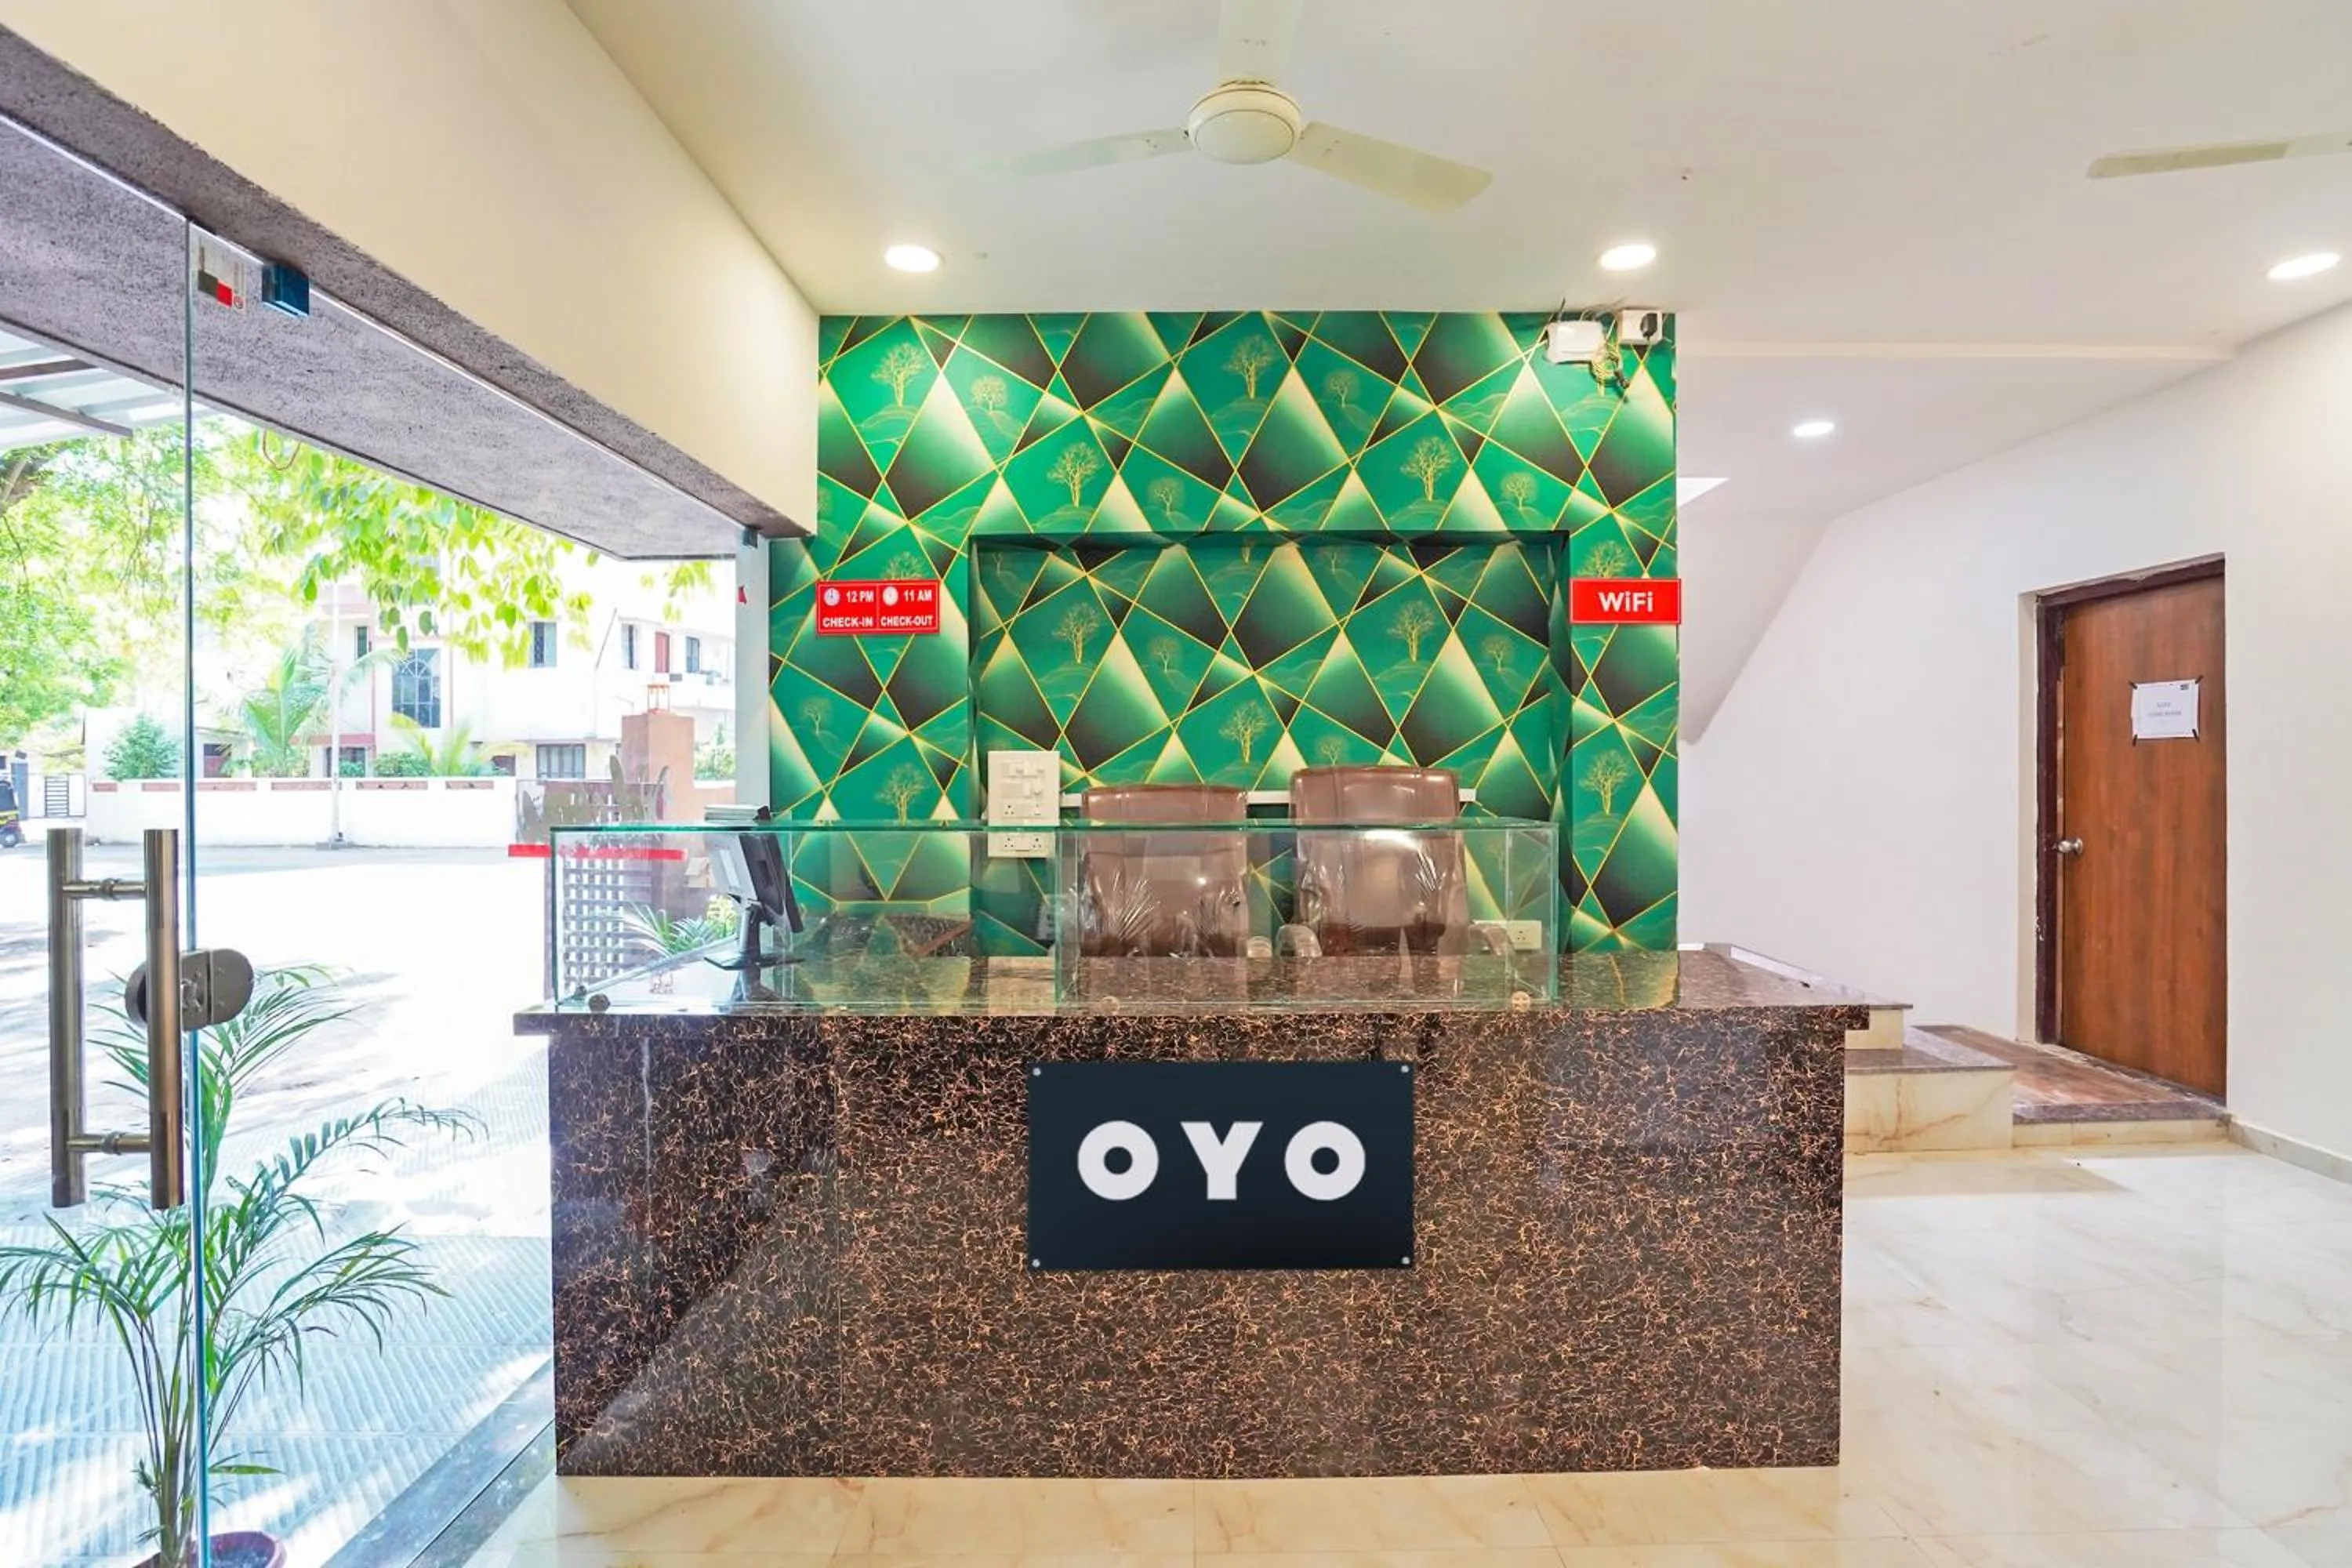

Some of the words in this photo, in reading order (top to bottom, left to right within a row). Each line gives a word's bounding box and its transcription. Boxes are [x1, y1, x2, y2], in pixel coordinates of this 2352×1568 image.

[846, 590, 858, 603] 12
[859, 590, 874, 602] PM
[903, 590, 914, 602] 11
[916, 590, 933, 602] AM
[1598, 590, 1654, 612] WiFi
[823, 616, 873, 628] CHECK-IN
[880, 615, 933, 626] CHECK-OUT
[1077, 1120, 1367, 1201] OYO
